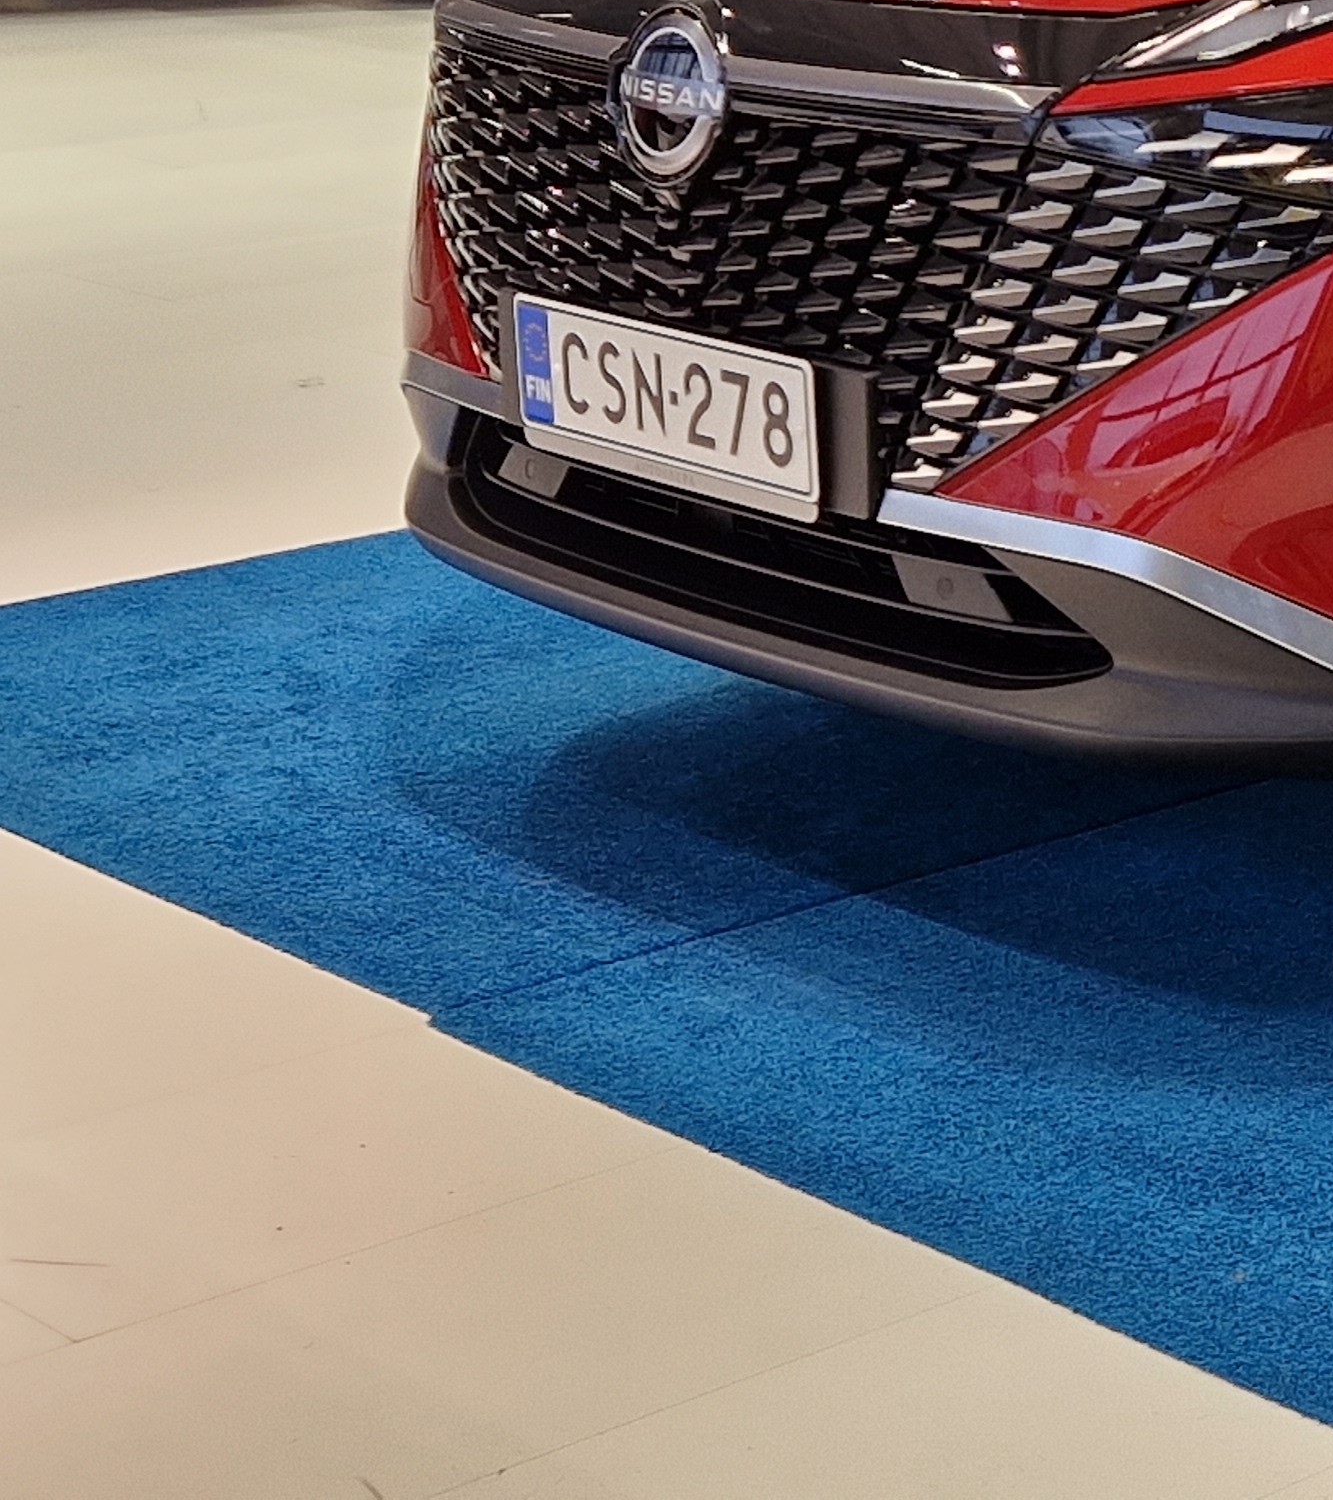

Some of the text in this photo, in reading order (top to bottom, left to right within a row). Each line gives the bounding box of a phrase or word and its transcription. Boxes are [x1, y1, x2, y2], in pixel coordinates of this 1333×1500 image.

[619, 72, 725, 111] NISSAN
[525, 374, 552, 404] FIN
[561, 331, 793, 468] CSN-278
